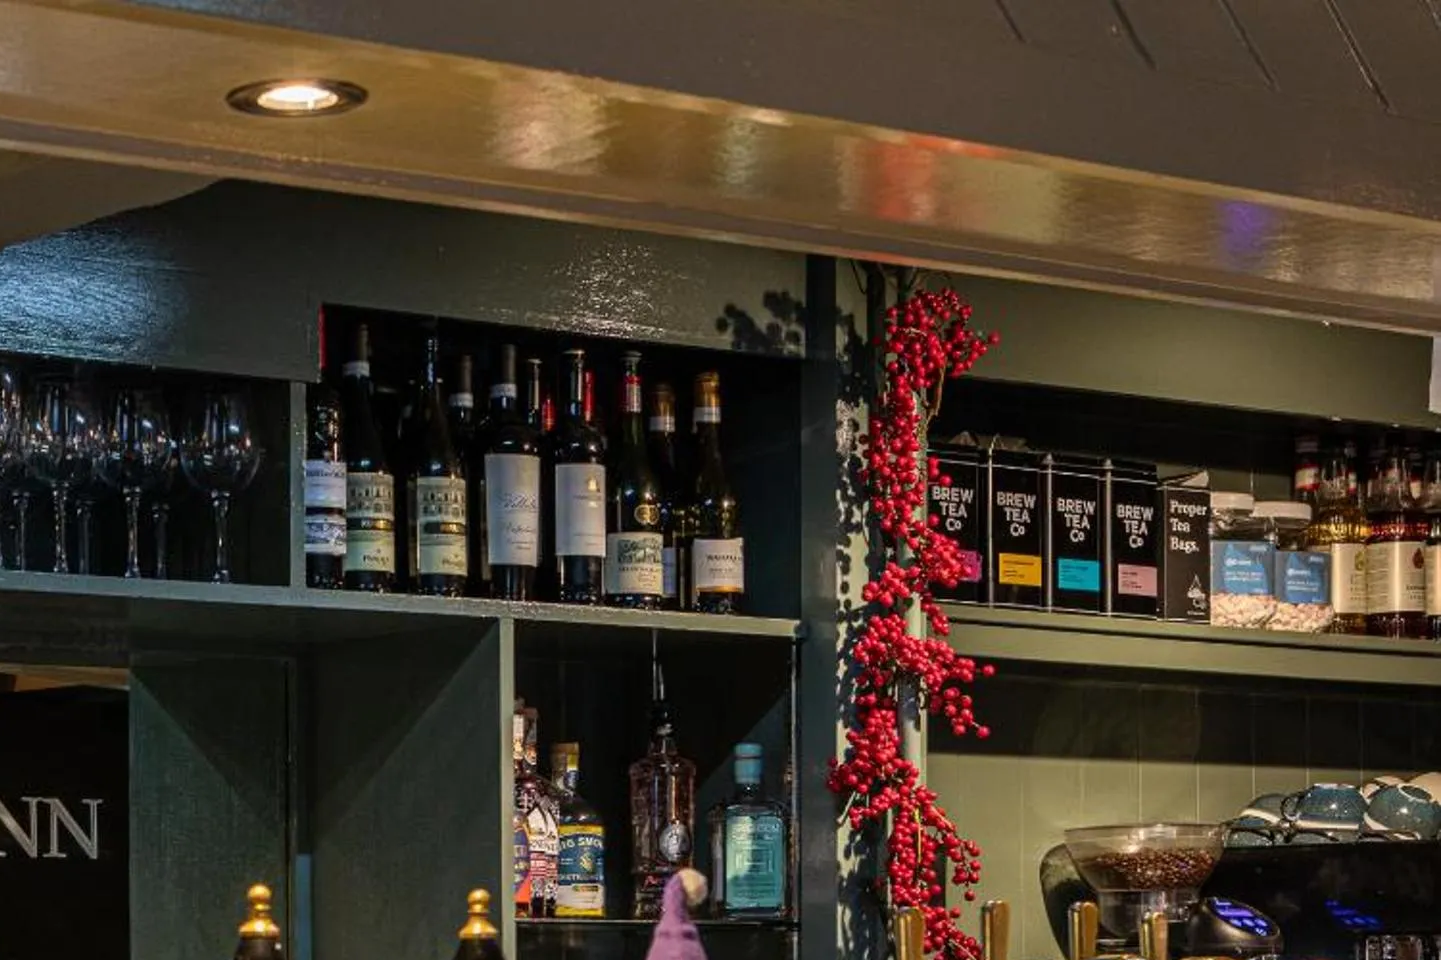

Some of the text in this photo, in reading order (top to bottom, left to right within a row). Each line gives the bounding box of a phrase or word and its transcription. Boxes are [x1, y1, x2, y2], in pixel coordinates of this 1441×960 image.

[931, 486, 974, 504] BREW
[996, 491, 1037, 509] BREW
[939, 501, 968, 518] TEA
[1056, 497, 1097, 515] BREW
[1116, 504, 1154, 522] BREW
[1169, 499, 1208, 517] Proper
[1003, 507, 1031, 524] TEA
[1064, 513, 1091, 530] TEA
[1123, 519, 1148, 536] TEA
[1169, 518, 1191, 533] Tea
